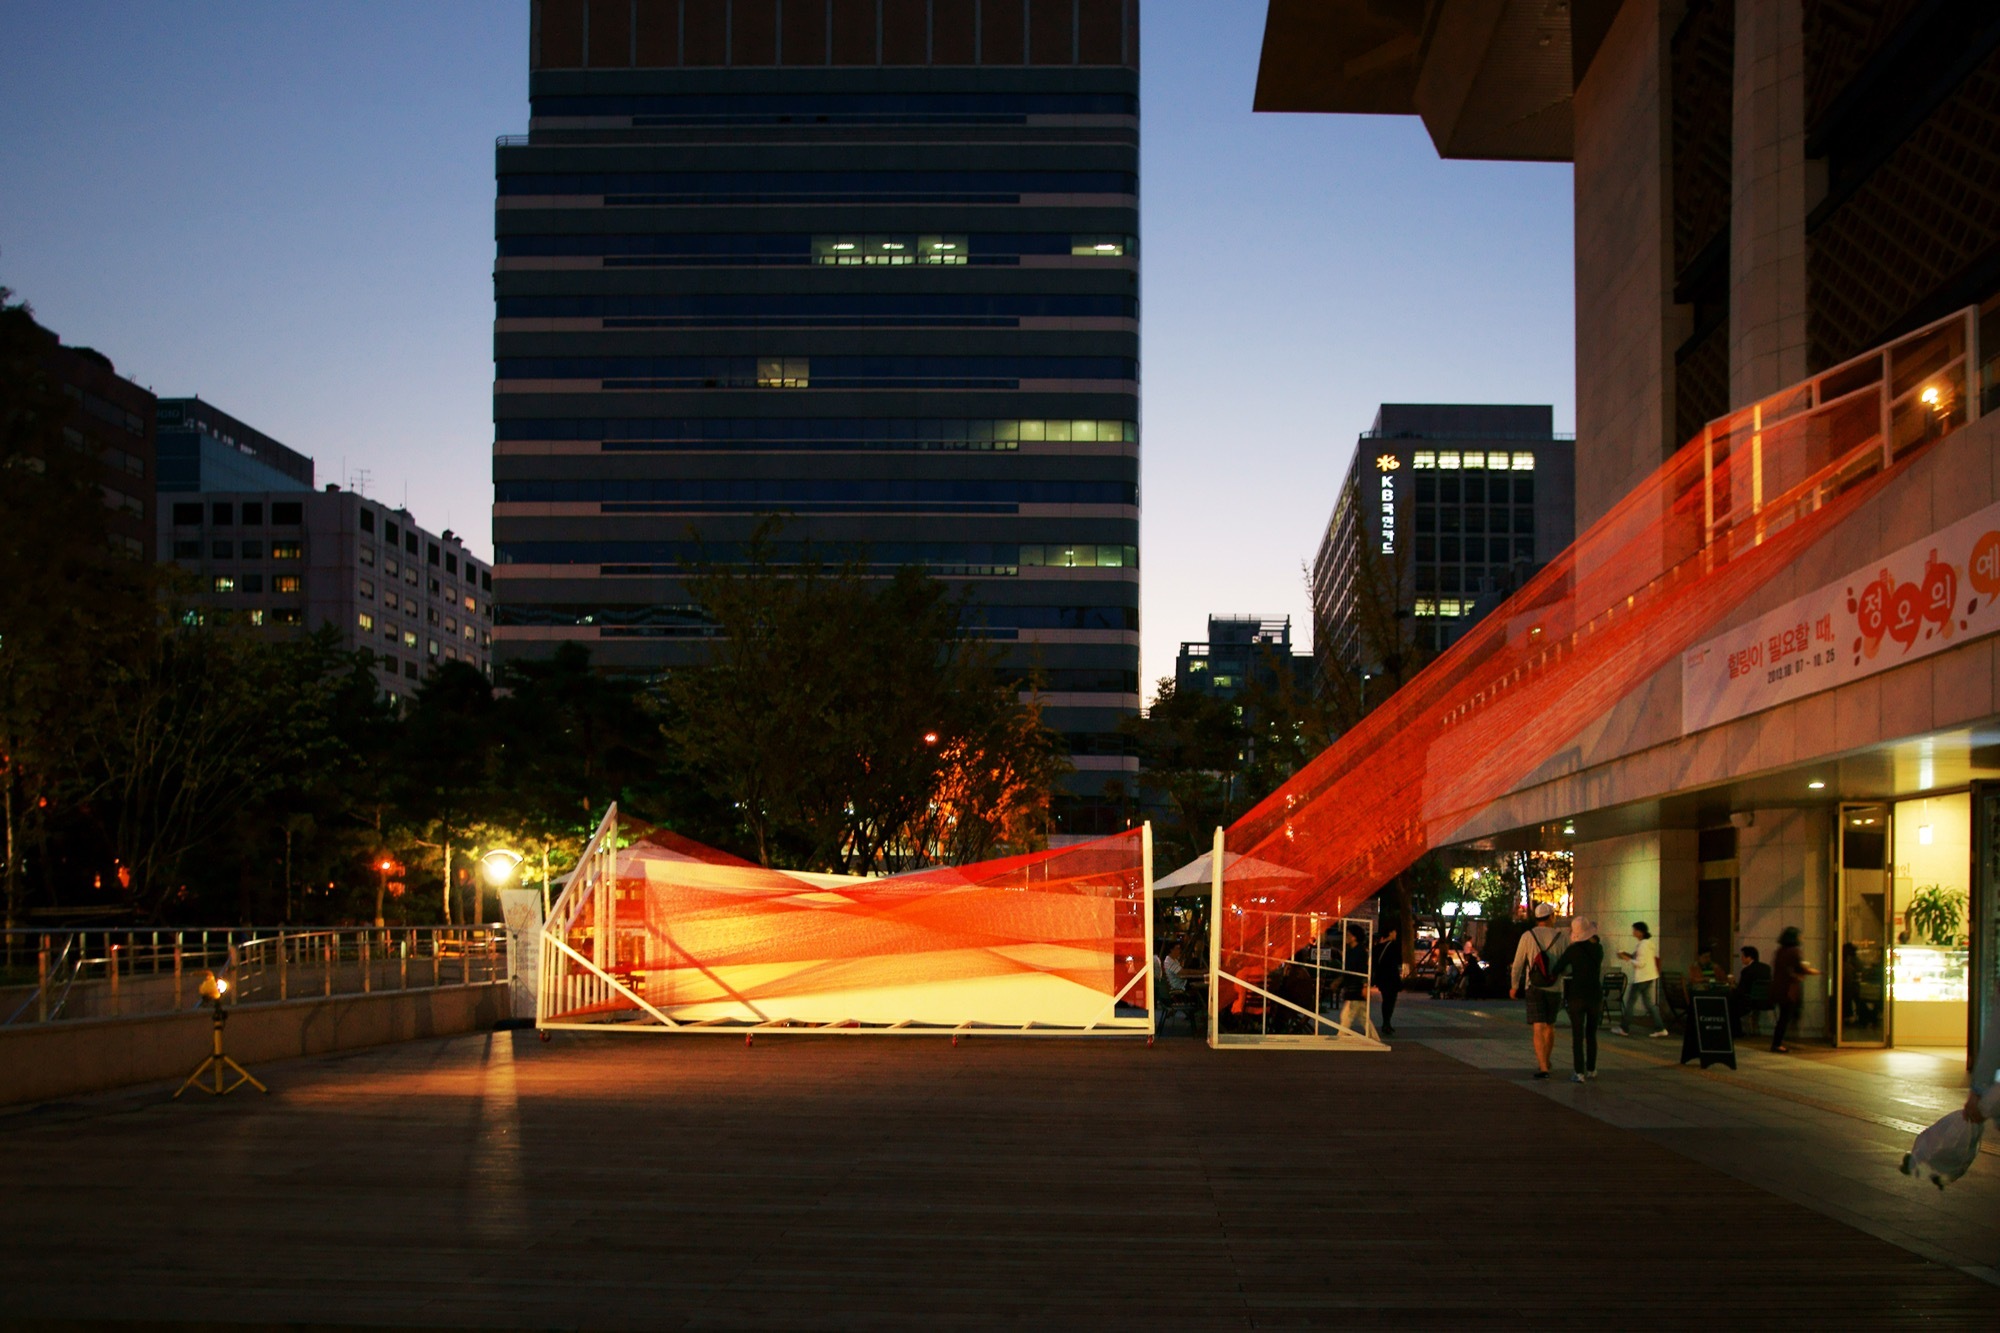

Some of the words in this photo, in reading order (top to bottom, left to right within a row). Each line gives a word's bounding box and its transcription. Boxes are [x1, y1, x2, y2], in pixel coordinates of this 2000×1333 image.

[1864, 573, 1951, 630] 정오의
[1727, 641, 1764, 680] 힐링이
[1768, 623, 1810, 663] 필요할
[1815, 613, 1836, 643] 때,
